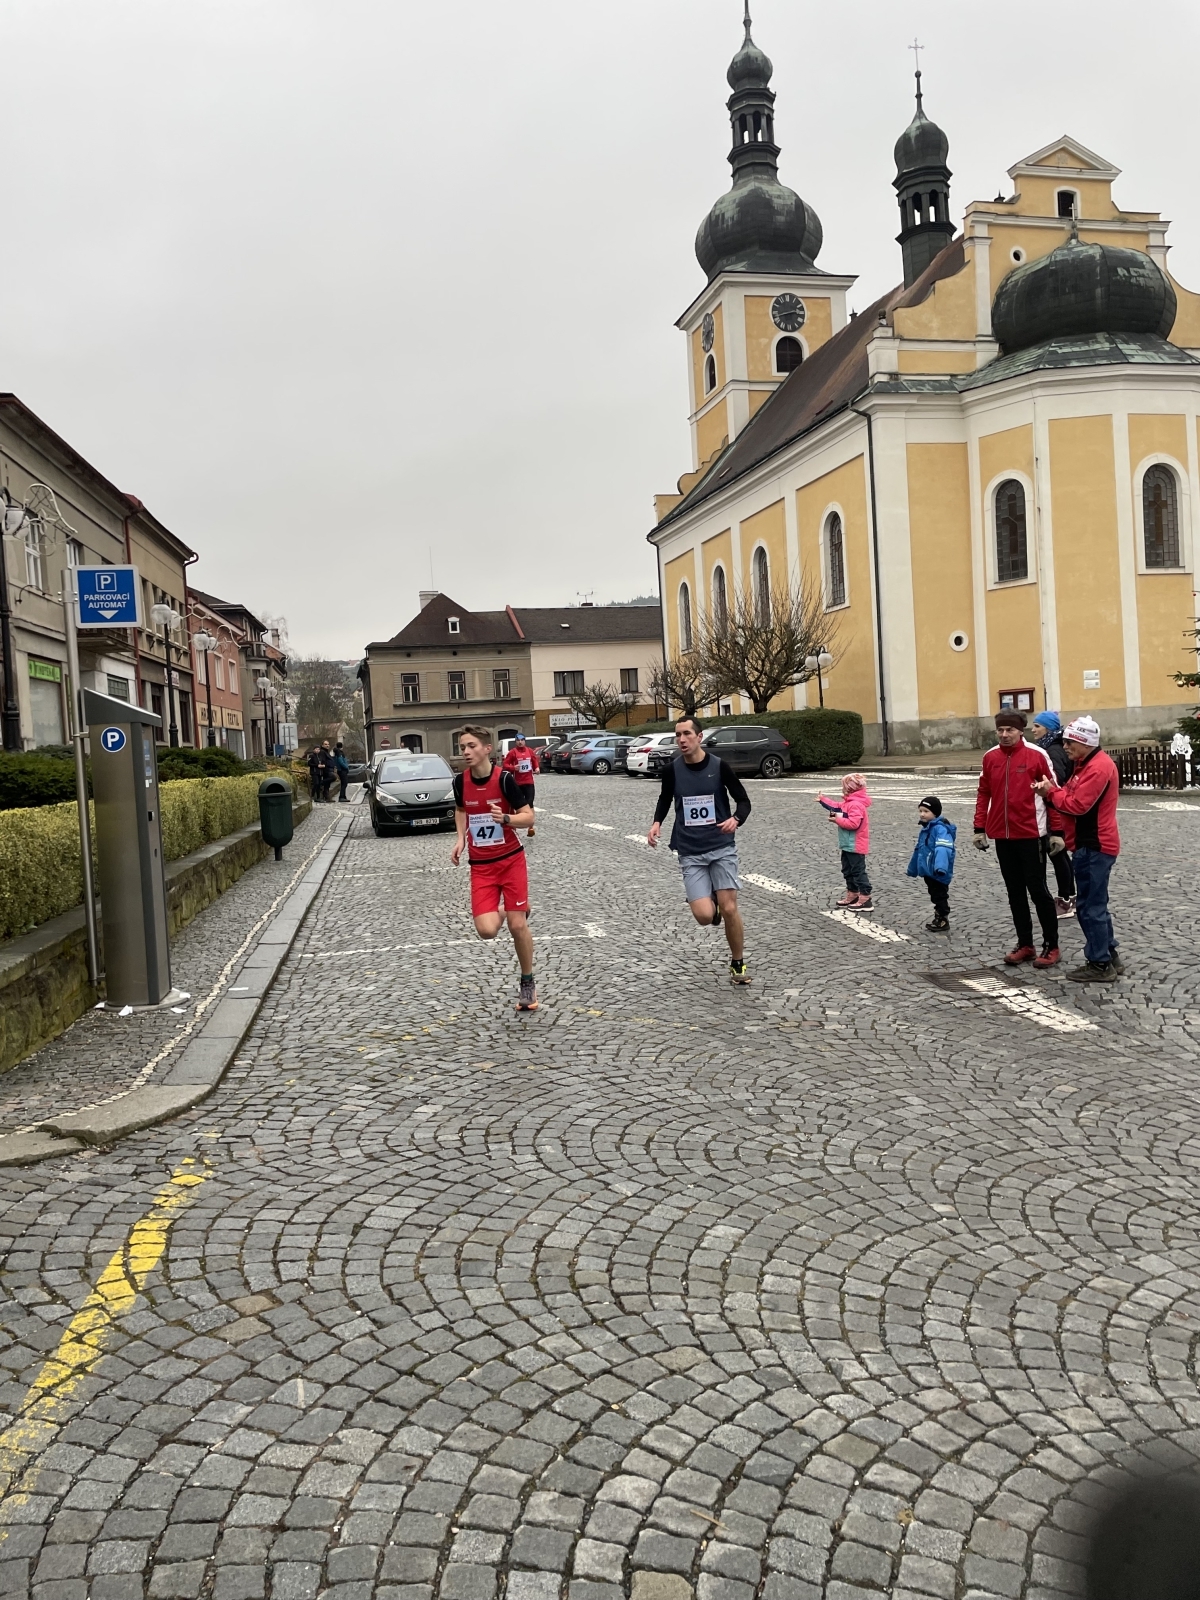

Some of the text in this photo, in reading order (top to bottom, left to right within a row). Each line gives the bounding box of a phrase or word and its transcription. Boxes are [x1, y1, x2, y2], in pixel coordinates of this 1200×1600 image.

[100, 575, 111, 590] P
[83, 592, 130, 601] PARKOVACÍ
[88, 601, 127, 609] AUTOMAT
[106, 731, 120, 748] P
[690, 807, 709, 819] 80
[476, 825, 496, 839] 47
